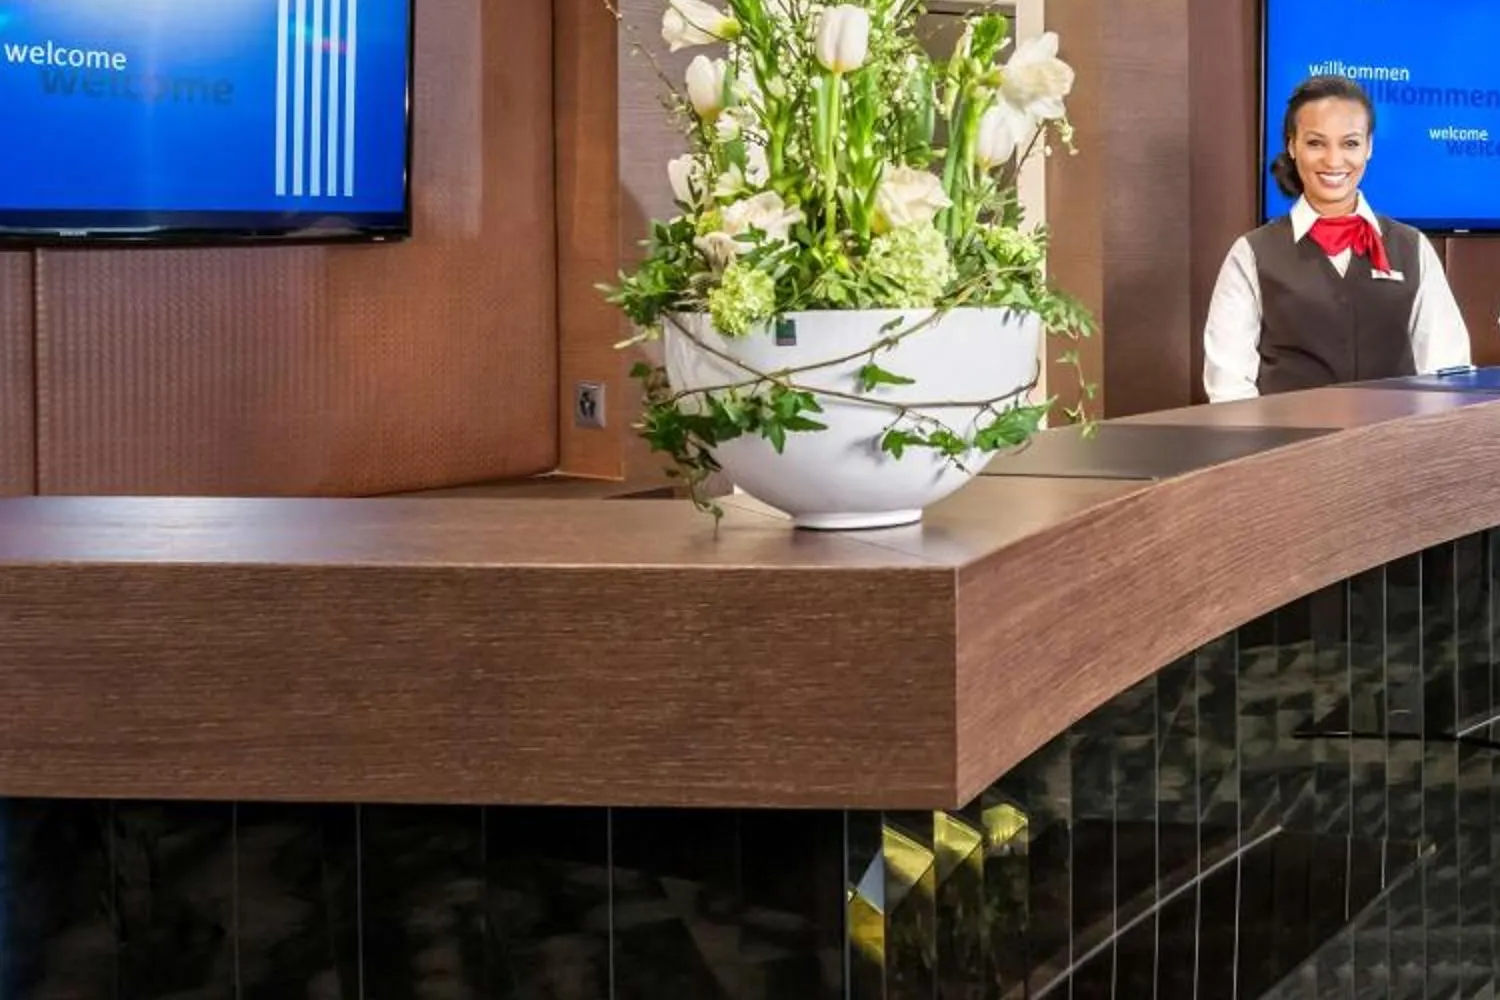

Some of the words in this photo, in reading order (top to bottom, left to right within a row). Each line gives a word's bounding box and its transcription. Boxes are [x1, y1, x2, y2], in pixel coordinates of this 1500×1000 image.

[4, 40, 127, 71] welcome
[1309, 61, 1410, 81] willkommen
[1366, 81, 1500, 109] llkommen
[1429, 126, 1489, 141] welcome
